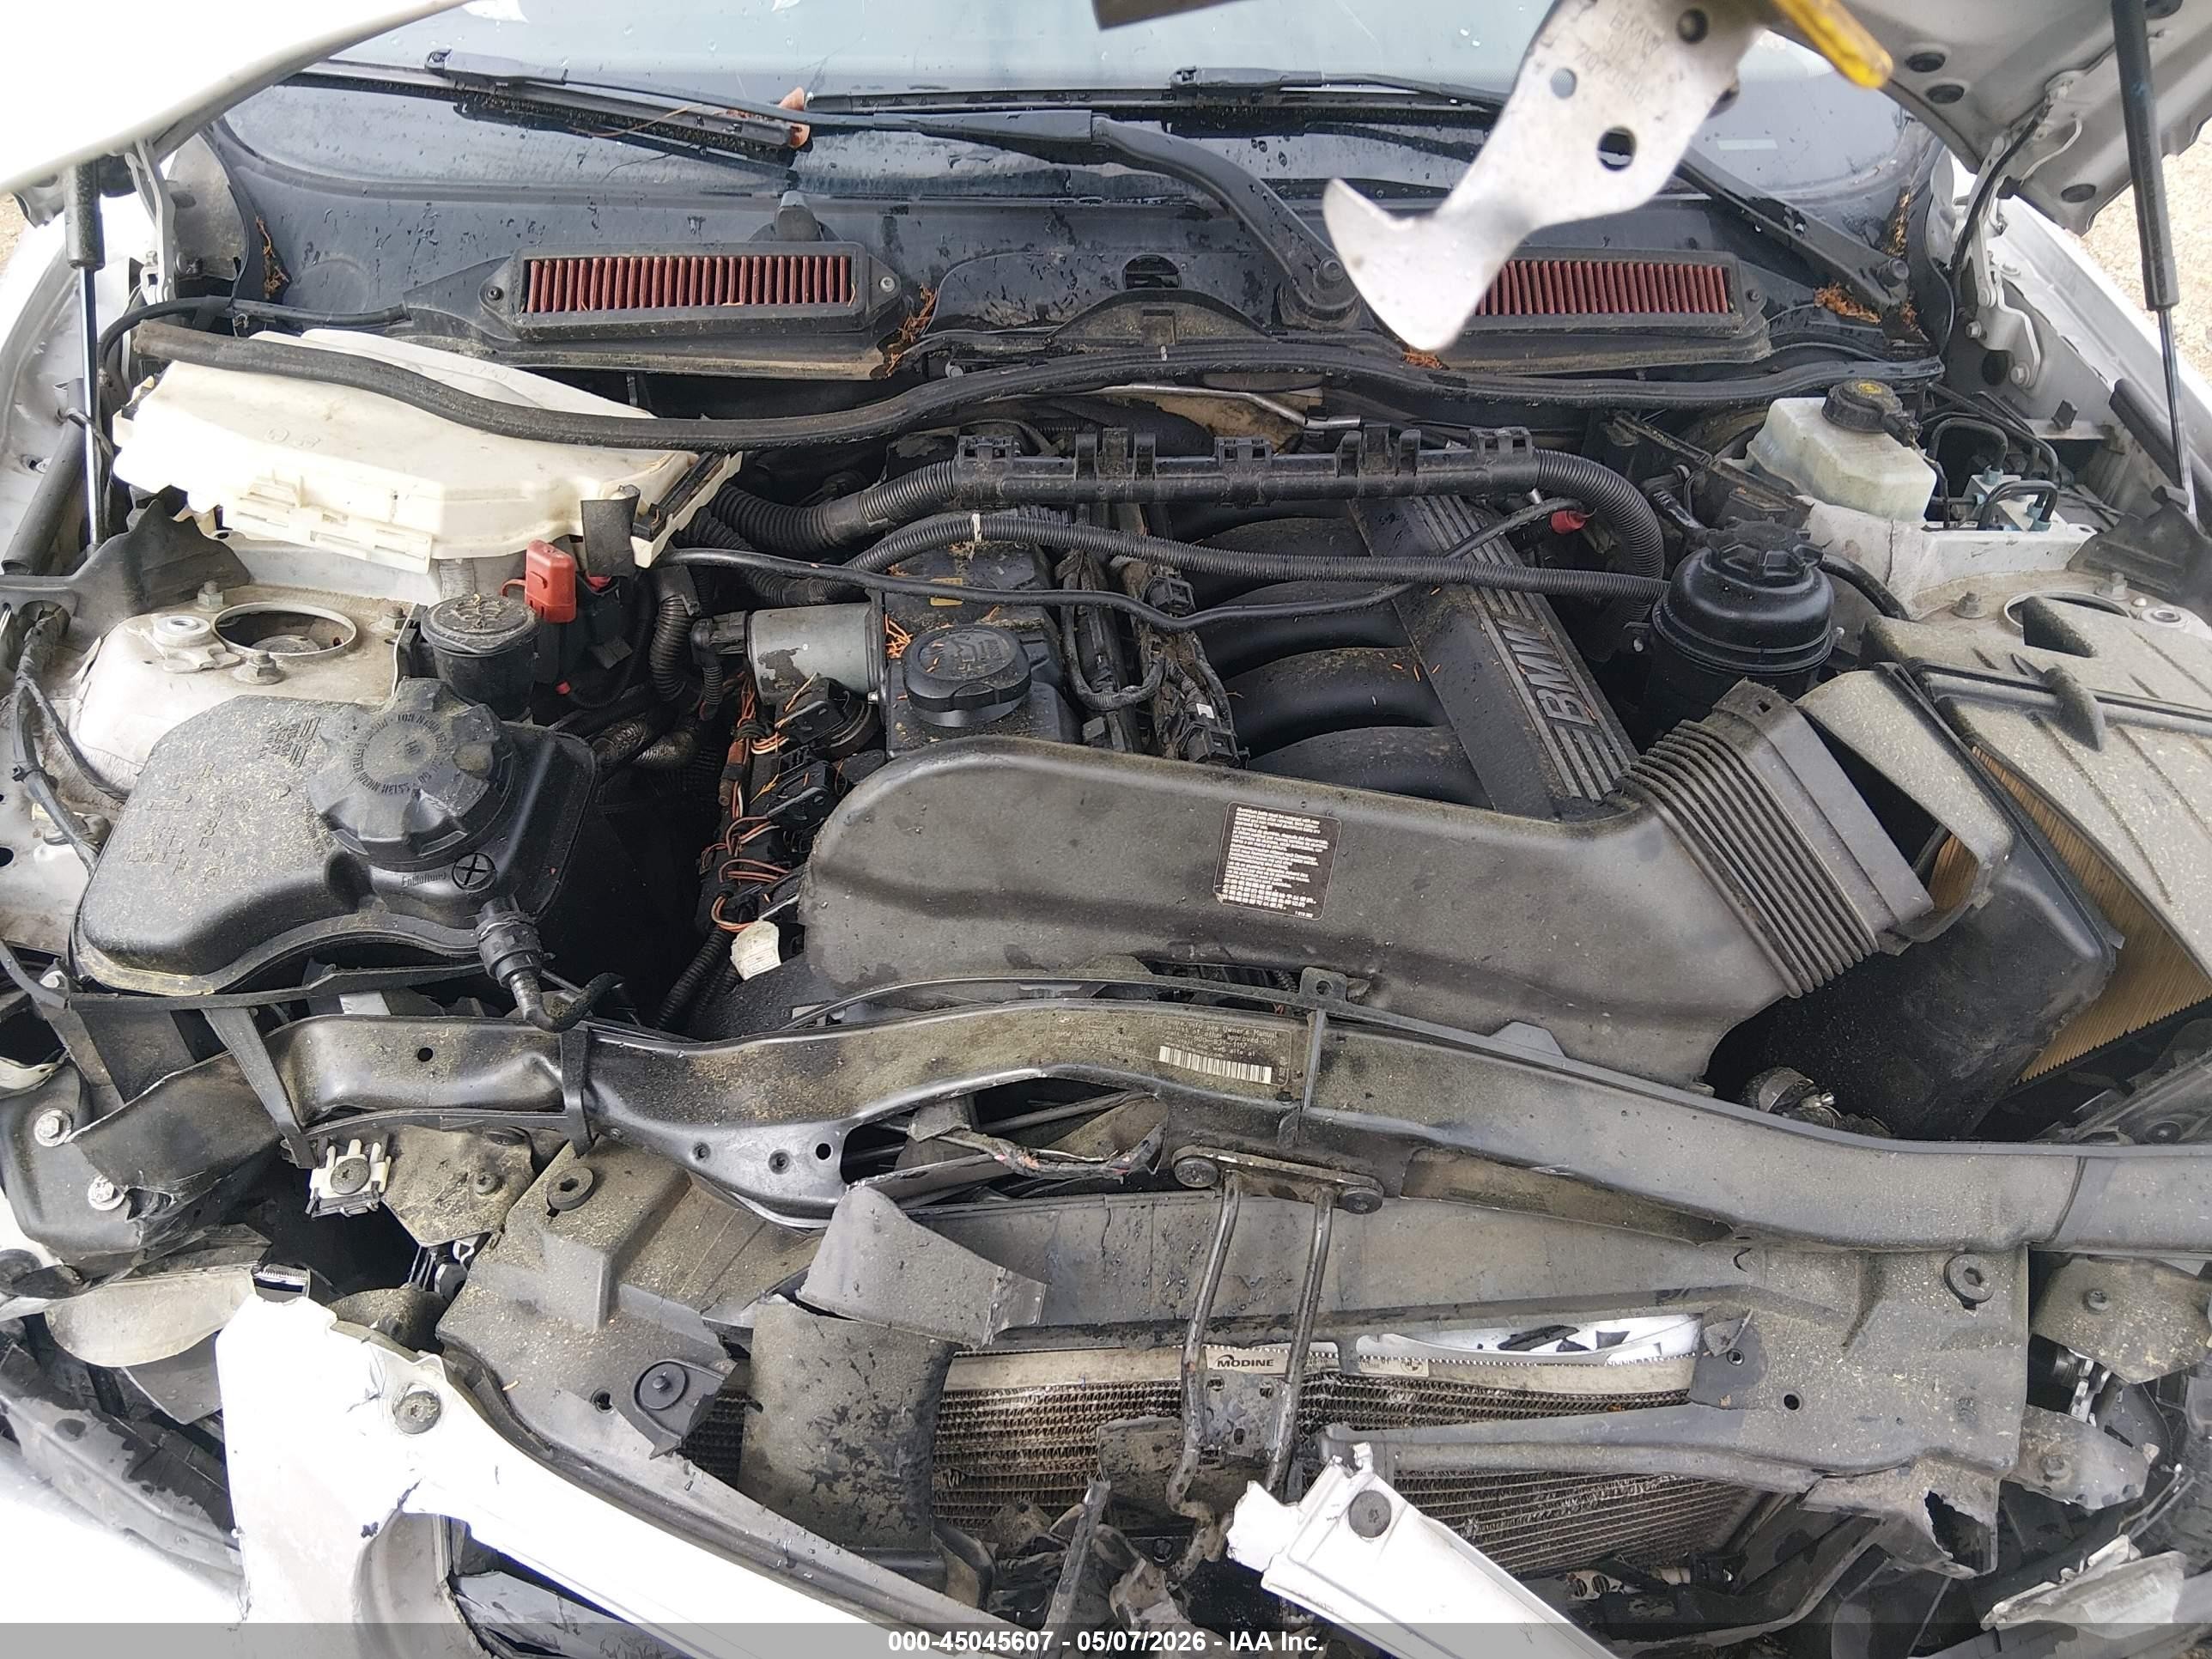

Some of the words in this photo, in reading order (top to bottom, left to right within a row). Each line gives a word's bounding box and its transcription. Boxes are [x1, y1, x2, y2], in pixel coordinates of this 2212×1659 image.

[1496, 617, 1596, 727] BMW
[1252, 1028, 1277, 1039] Manual
[1217, 1359, 1274, 1367] MODINE
